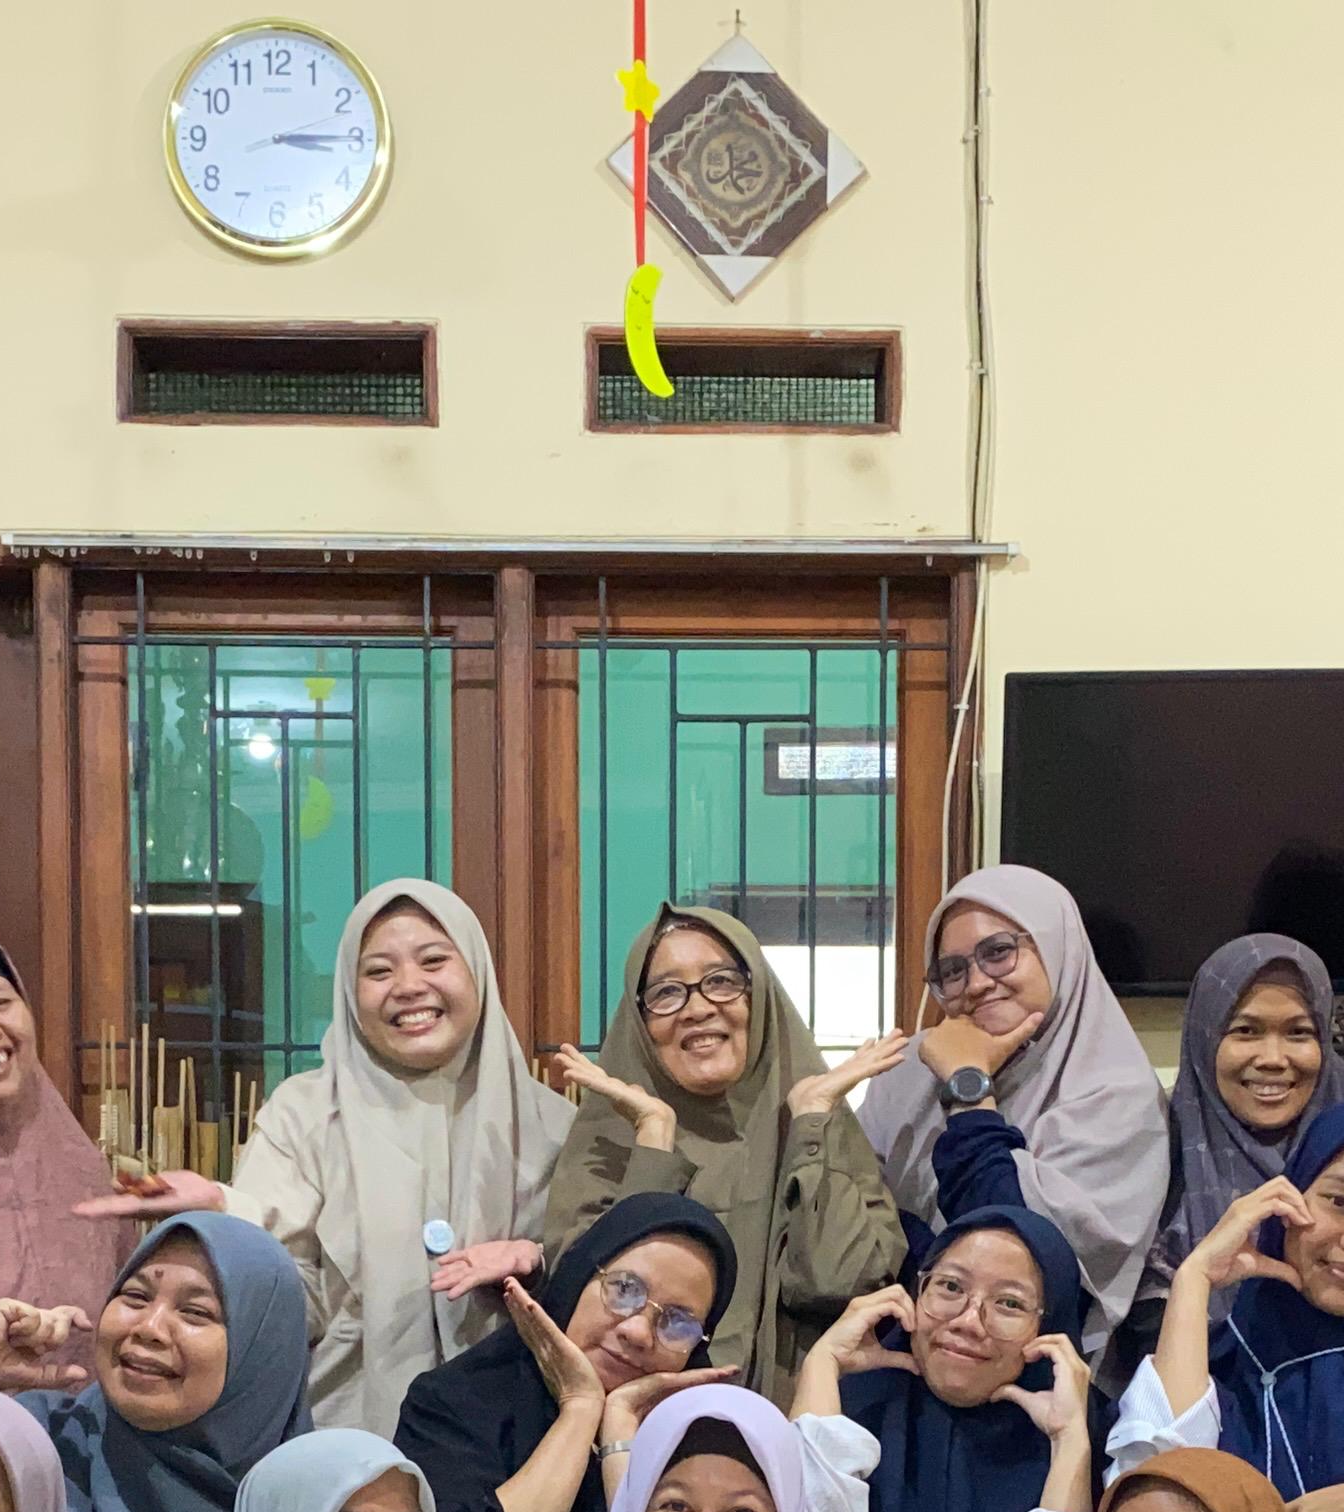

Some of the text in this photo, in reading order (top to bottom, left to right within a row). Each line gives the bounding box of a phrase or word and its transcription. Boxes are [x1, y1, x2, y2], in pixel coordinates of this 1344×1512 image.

[229, 59, 252, 86] 11
[262, 49, 292, 76] 12
[307, 60, 317, 86] 1
[203, 88, 230, 114] 10
[334, 87, 352, 114] 2
[189, 125, 207, 152] 9
[347, 126, 365, 153] 3
[203, 164, 220, 192] 8
[335, 165, 351, 192] 4
[234, 191, 251, 218] 7
[268, 200, 286, 228] 6
